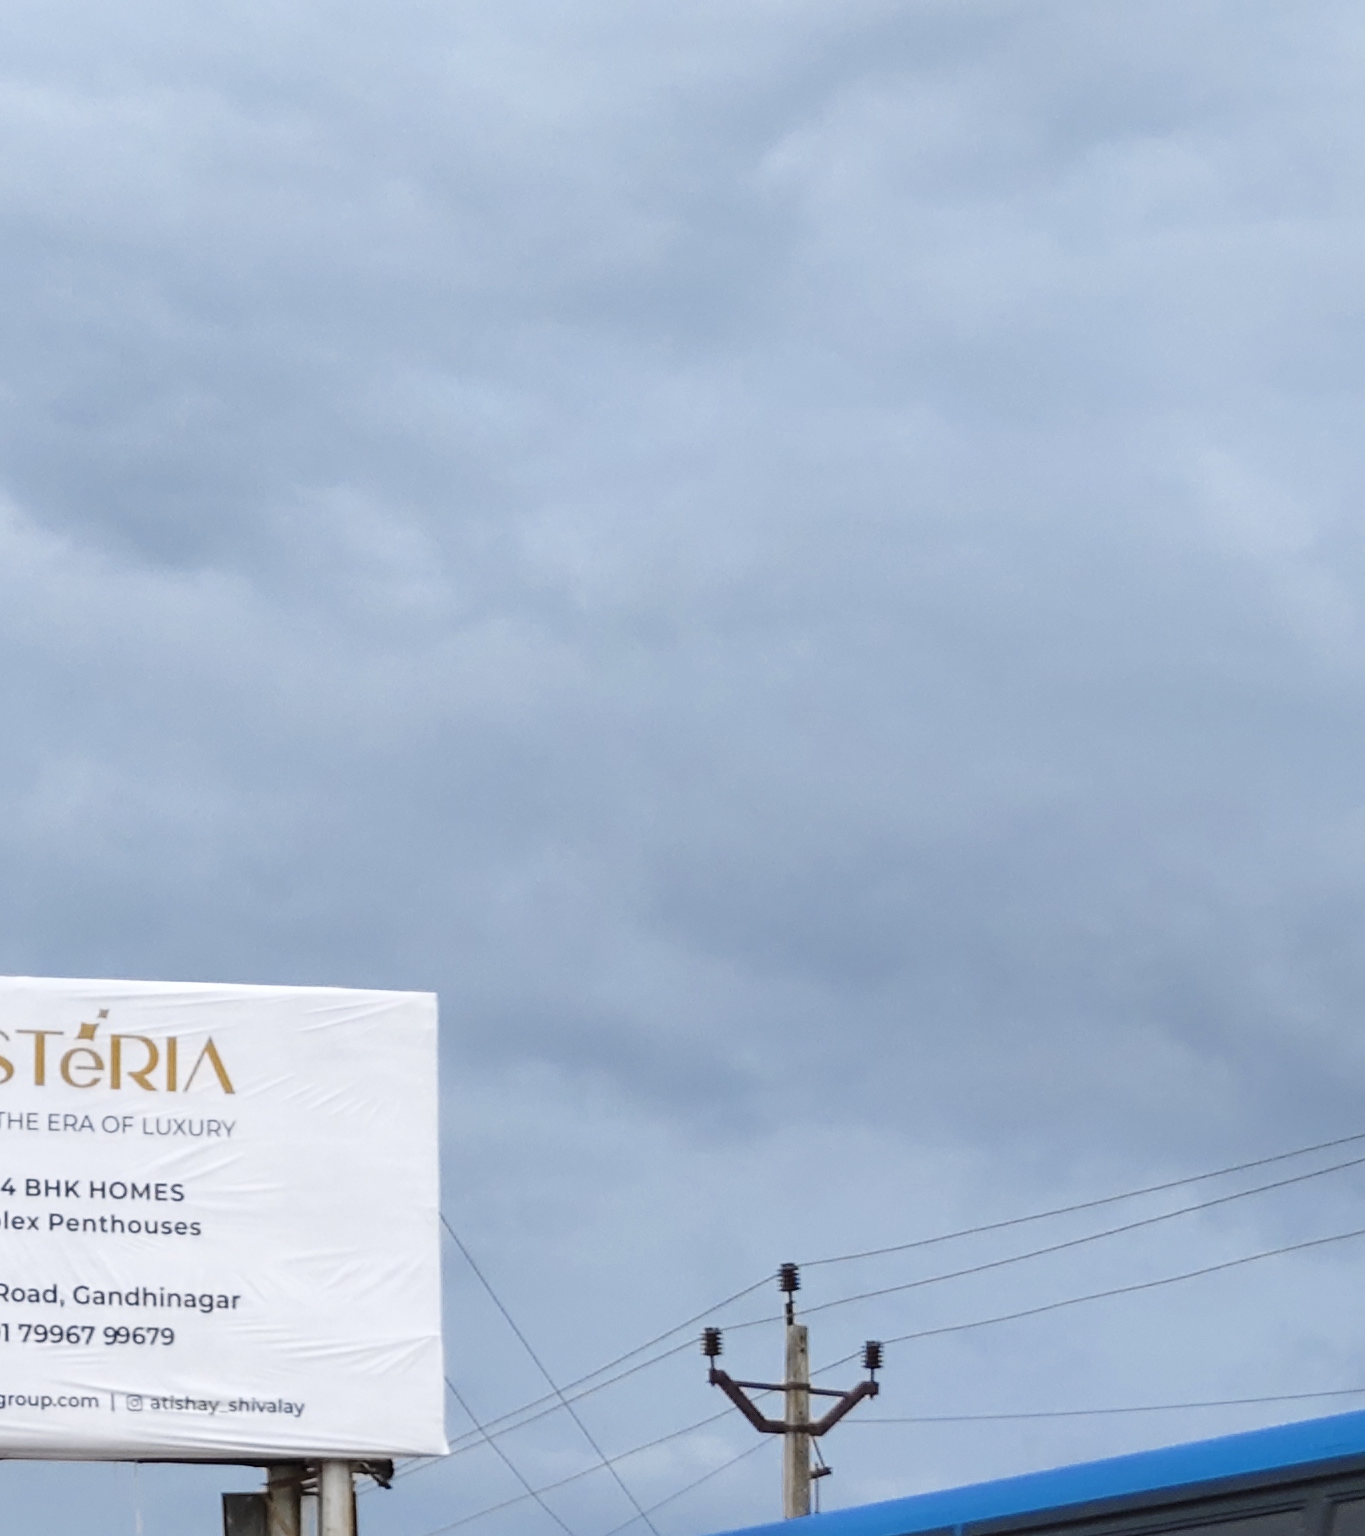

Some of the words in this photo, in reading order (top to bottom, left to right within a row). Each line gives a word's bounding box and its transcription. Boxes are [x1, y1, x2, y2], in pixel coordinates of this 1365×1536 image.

[47, 1113, 95, 1133] ERA
[101, 1115, 135, 1134] OF
[141, 1116, 237, 1138] LUXURY
[0, 1176, 17, 1197] 4
[25, 1178, 81, 1199] BHK
[89, 1180, 186, 1202] HOMES
[48, 1213, 202, 1237] Penthouses
[72, 1284, 242, 1313] Gandhinagar
[18, 1323, 96, 1346] 79967
[102, 1325, 176, 1347] 99679
[149, 1396, 306, 1418] atishay_shivalay
